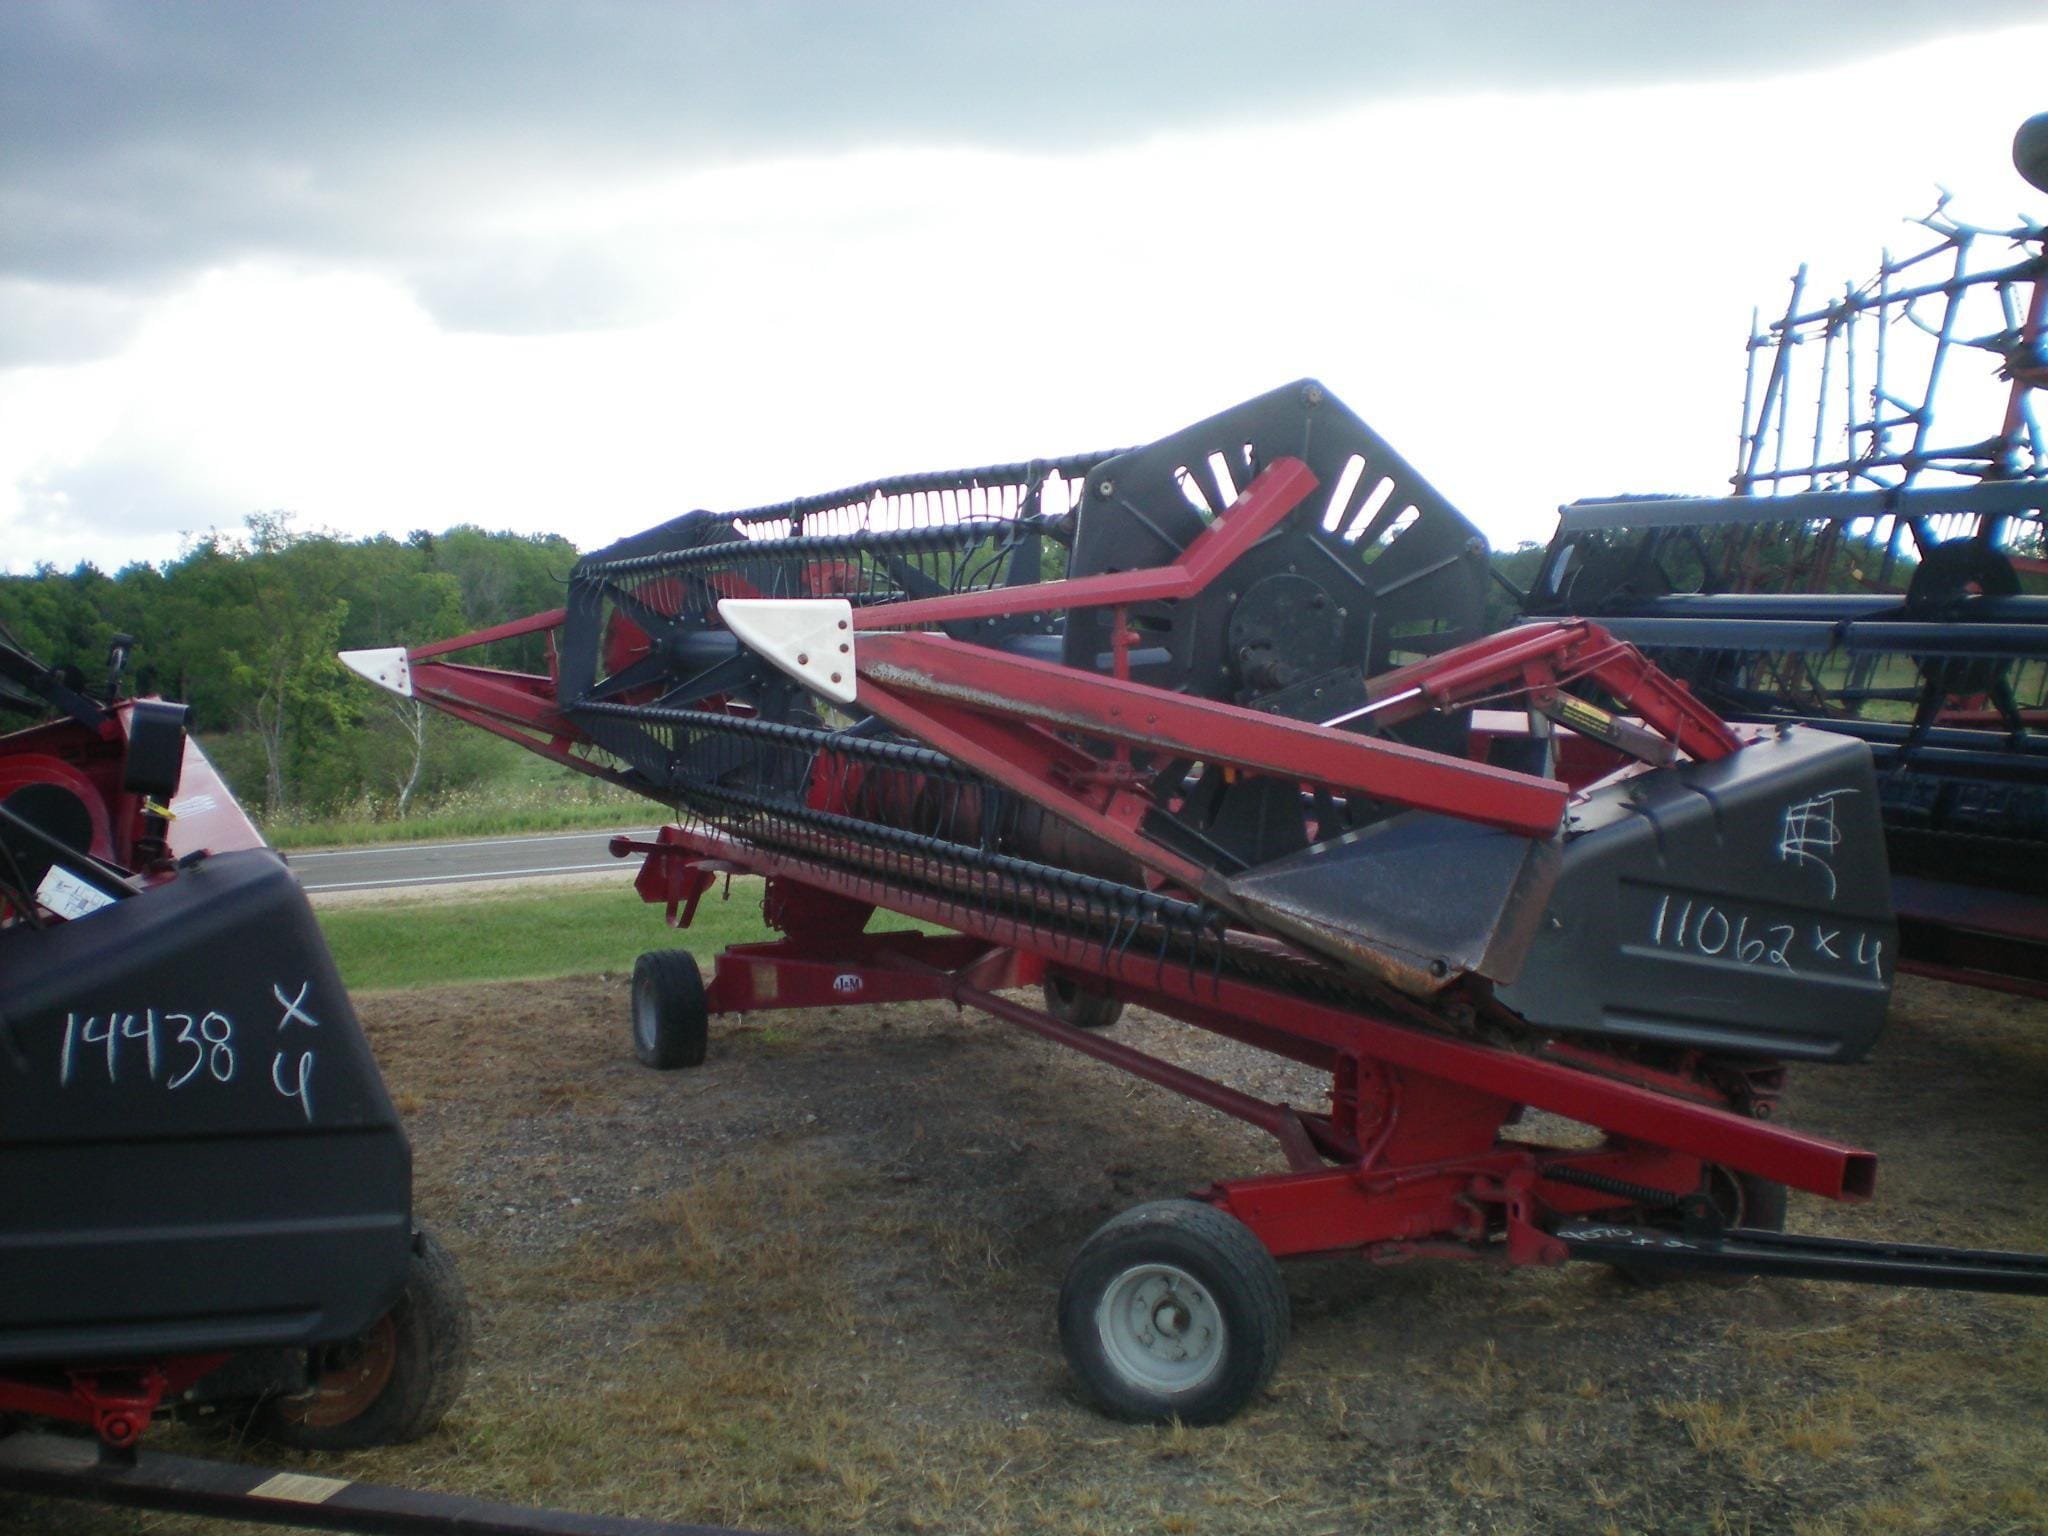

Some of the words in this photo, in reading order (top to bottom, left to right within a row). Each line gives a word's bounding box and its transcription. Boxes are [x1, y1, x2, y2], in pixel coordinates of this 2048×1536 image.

[1655, 895, 1797, 976] 11062
[1857, 932, 1884, 980] 4
[60, 1008, 234, 1090] 14438
